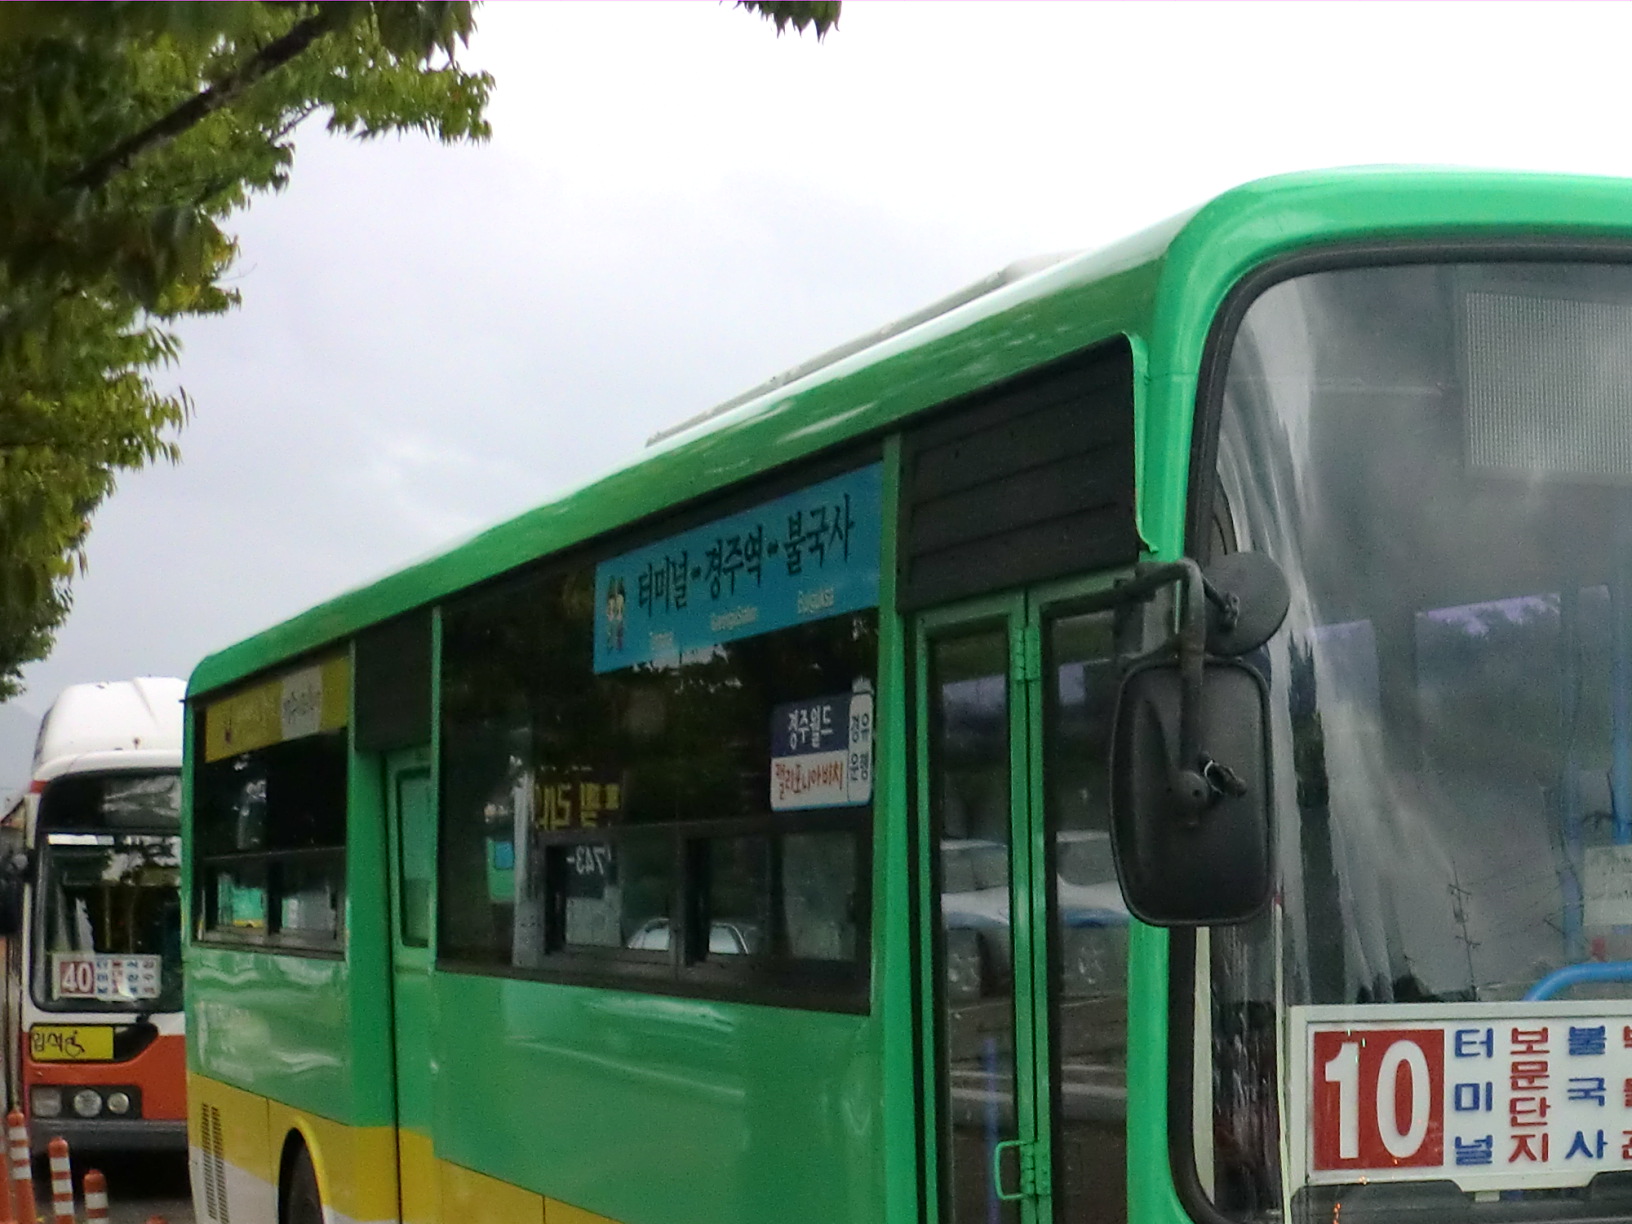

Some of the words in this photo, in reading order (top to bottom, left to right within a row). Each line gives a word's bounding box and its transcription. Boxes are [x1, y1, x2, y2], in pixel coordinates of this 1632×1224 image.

[638, 550, 688, 618] 터미널
[704, 524, 764, 600] 경주역
[783, 493, 855, 576] 불국사
[788, 705, 834, 750] 경주월드
[61, 961, 94, 993] 40
[1324, 1039, 1432, 1160] 10
[1453, 1027, 1494, 1166] 터미널
[1508, 1026, 1551, 1163] 보문단지
[1564, 1025, 1607, 1160] 불국사
